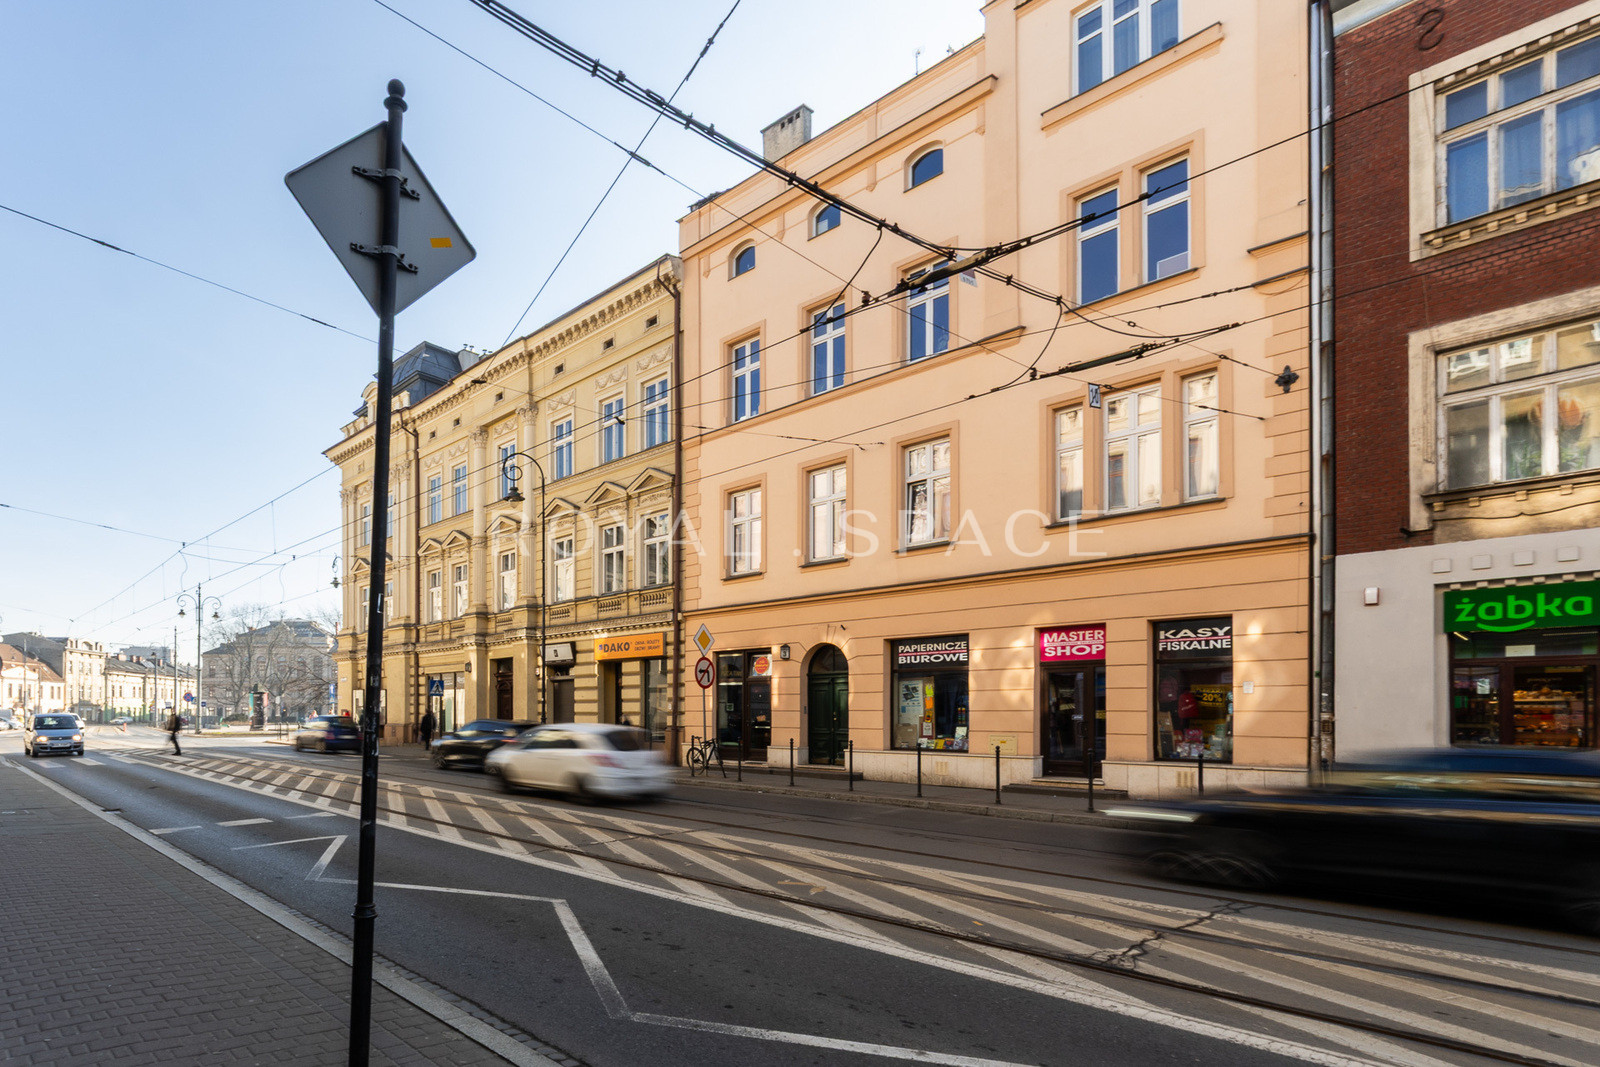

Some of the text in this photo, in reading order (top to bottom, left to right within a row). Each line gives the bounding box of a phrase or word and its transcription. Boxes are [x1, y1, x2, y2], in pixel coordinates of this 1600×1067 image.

[1455, 593, 1593, 622] żabka
[1043, 630, 1105, 643] MASTER
[1159, 626, 1231, 639] KASY
[603, 642, 630, 653] DAKO
[898, 641, 968, 653] PAPIERNICZE
[1044, 644, 1105, 657] SHOP
[1158, 639, 1232, 651] FISKALNE
[898, 653, 968, 664] BIUROWE
